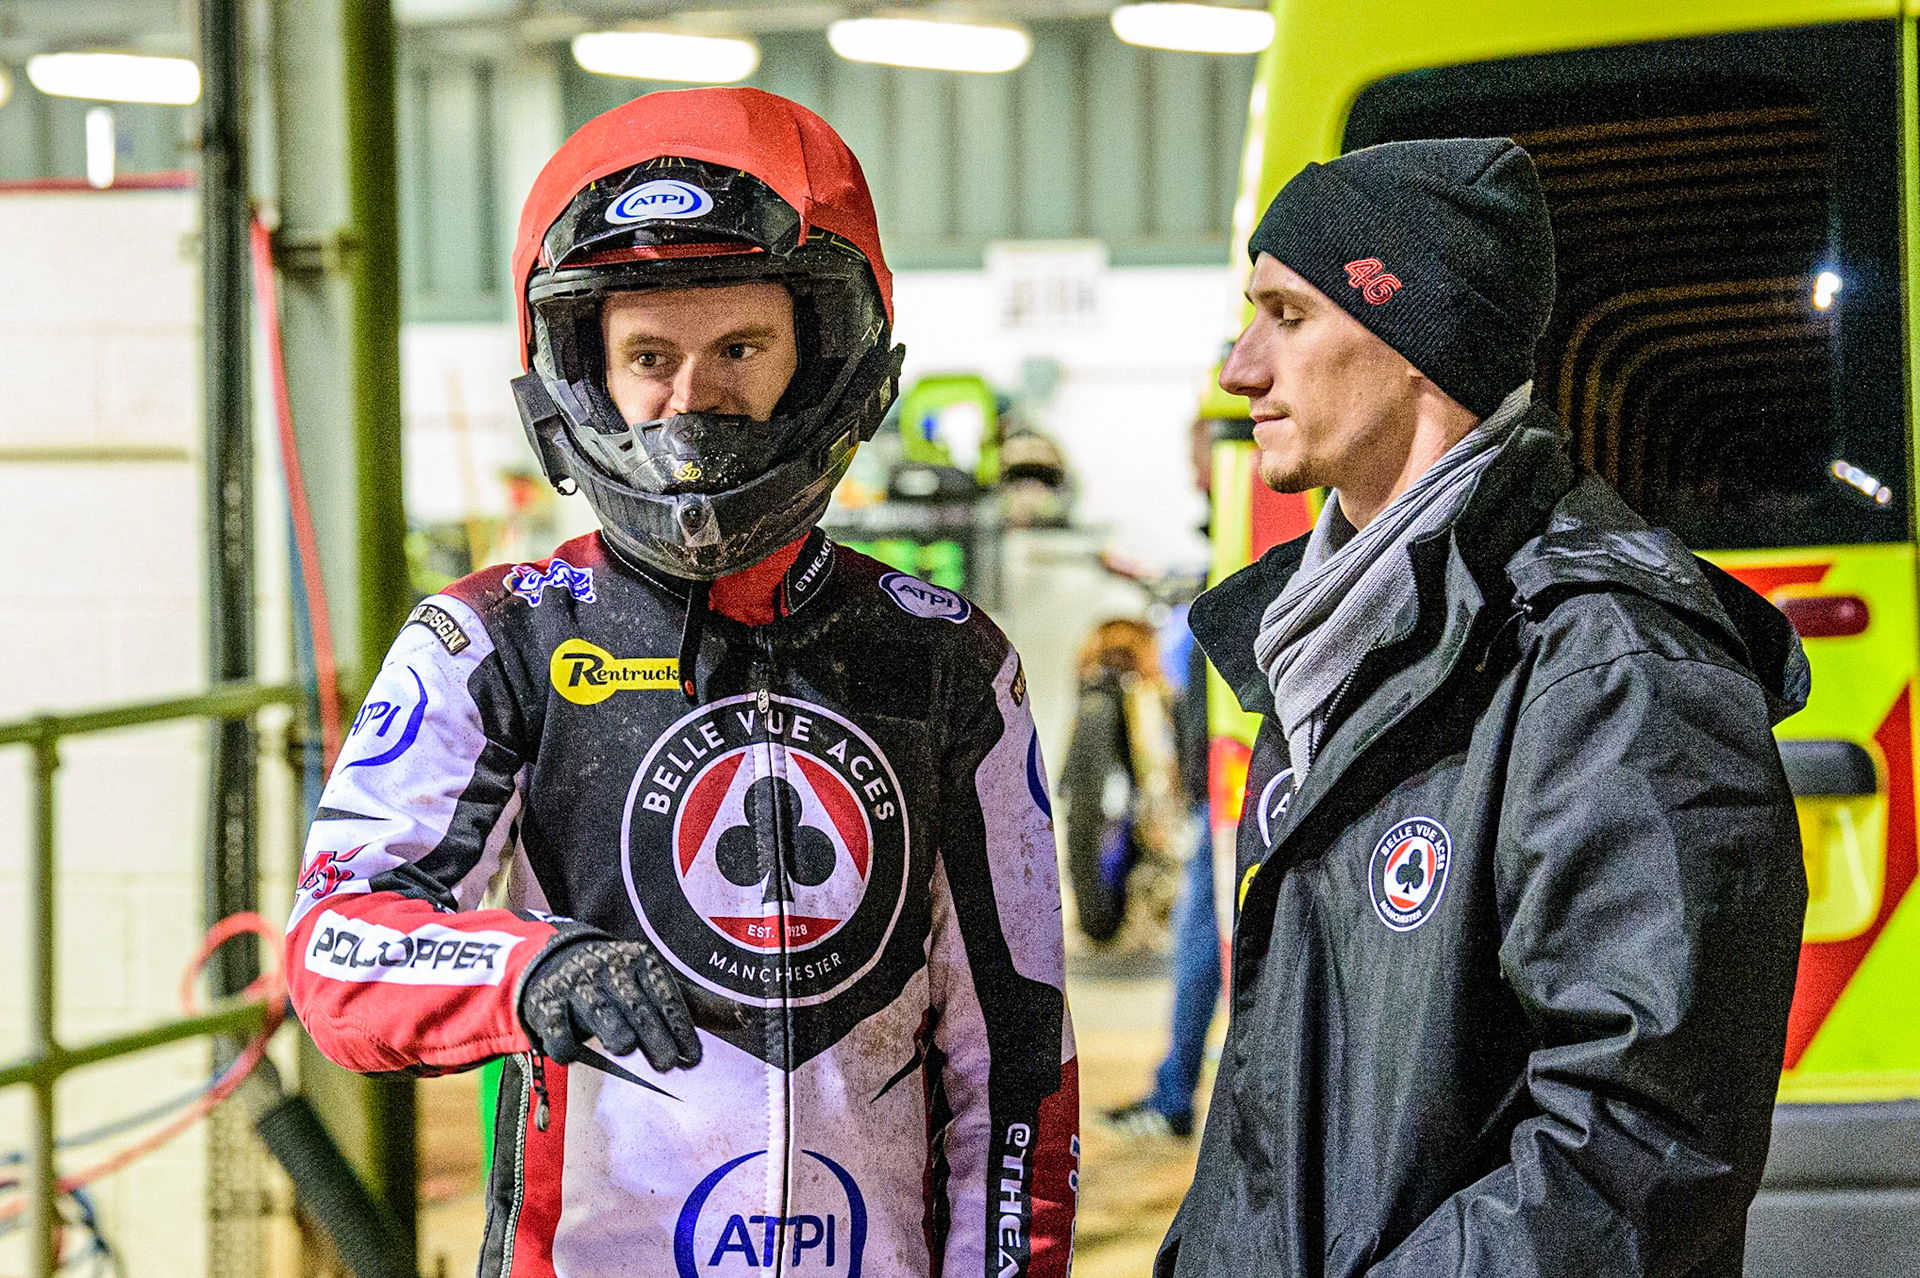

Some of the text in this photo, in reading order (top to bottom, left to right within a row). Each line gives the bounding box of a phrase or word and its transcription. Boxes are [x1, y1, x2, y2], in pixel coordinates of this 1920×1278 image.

[629, 194, 685, 209] ATPI
[1344, 257, 1403, 305] 46
[898, 585, 953, 607] ATPI
[642, 709, 895, 821] BELLE VUE ACES
[1380, 825, 1413, 856] BELLE
[1416, 824, 1438, 841] VUE
[1379, 900, 1423, 923] MANCHESTER
[747, 924, 775, 938] EST.
[708, 951, 842, 983] MANCHESTER
[708, 1214, 835, 1268] ATPI
